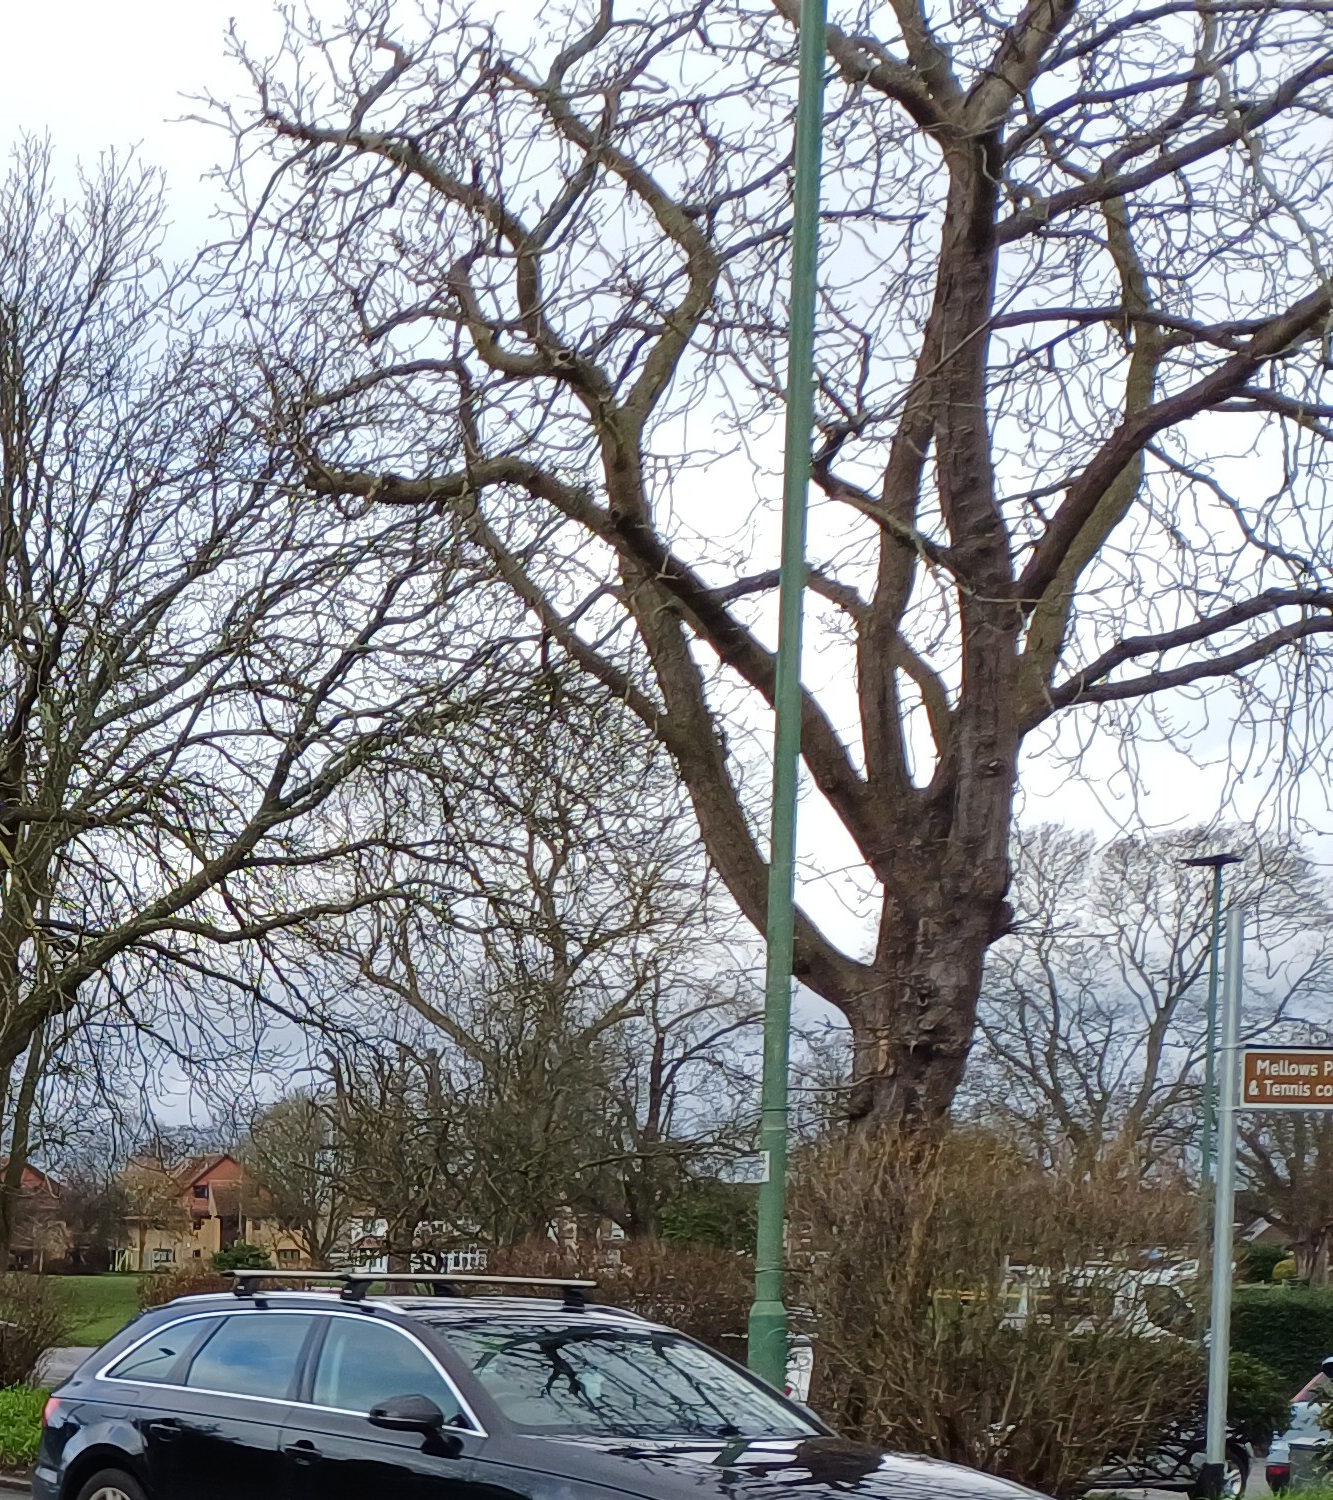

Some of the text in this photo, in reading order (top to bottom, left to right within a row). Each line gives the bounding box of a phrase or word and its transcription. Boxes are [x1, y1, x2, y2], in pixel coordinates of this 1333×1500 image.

[1256, 1059, 1319, 1077] Mellows
[1248, 1079, 1260, 1096] &
[1263, 1079, 1311, 1097] Tennis
